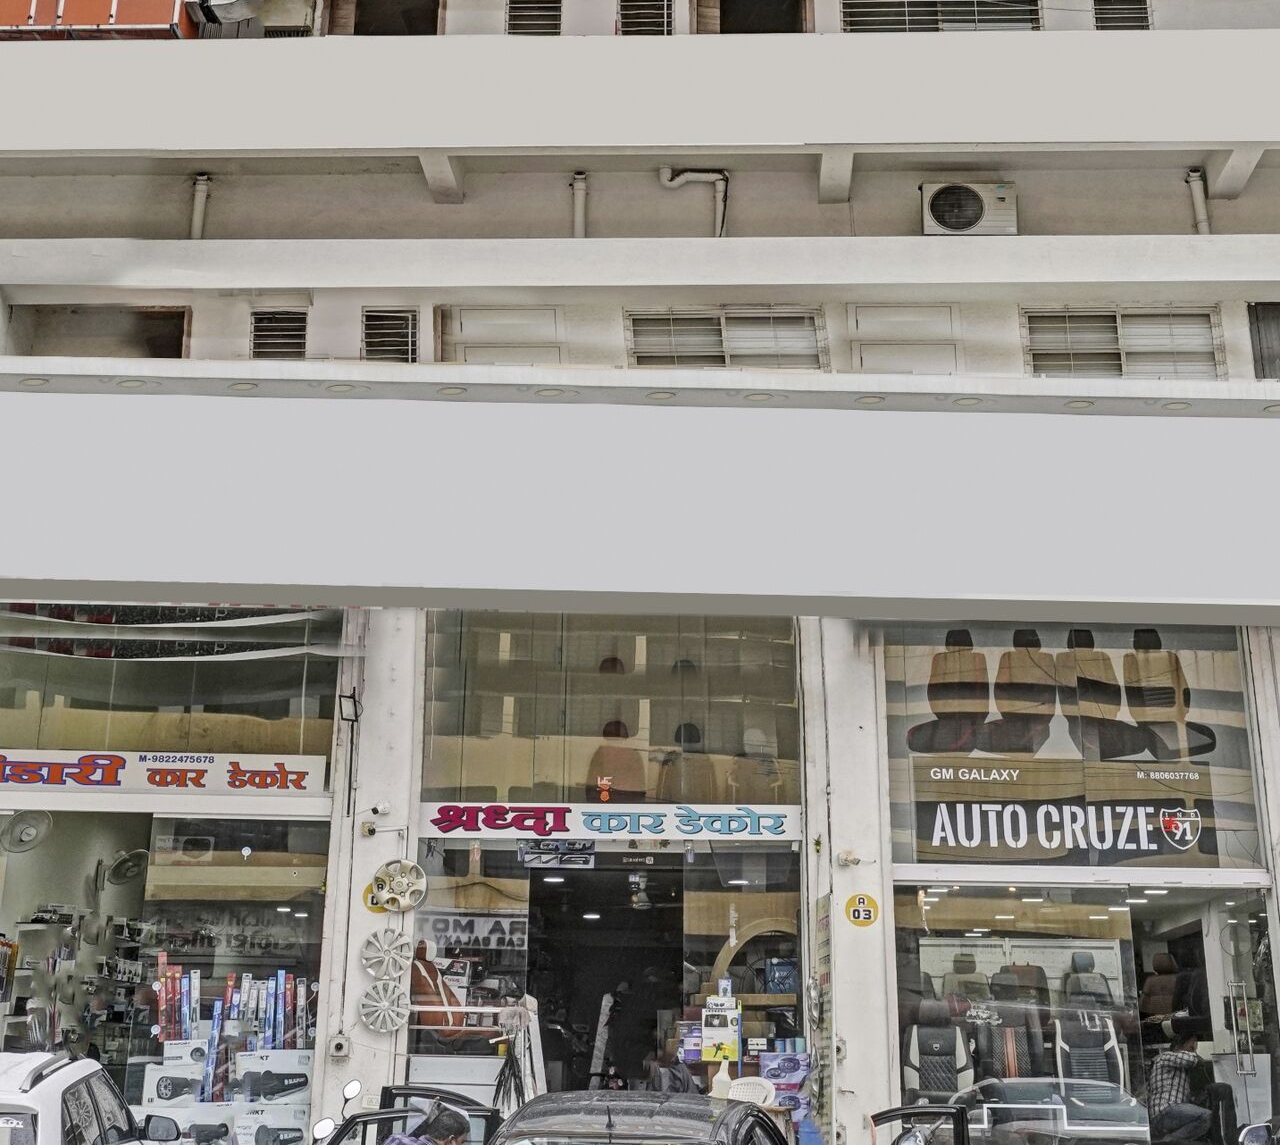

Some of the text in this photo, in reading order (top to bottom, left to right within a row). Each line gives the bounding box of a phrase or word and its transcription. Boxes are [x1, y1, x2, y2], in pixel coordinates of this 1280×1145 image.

[138, 754, 215, 764] M-9822475678
[146, 762, 309, 790] कार डेकोर
[930, 768, 1020, 782] GM GALAXY
[1137, 771, 1200, 781] M: 8806037768
[582, 811, 666, 834] कार
[674, 806, 786, 836] डेकोर
[931, 803, 1158, 851] AUTO CRUZE
[858, 897, 865, 905] A
[852, 909, 872, 920] 03
